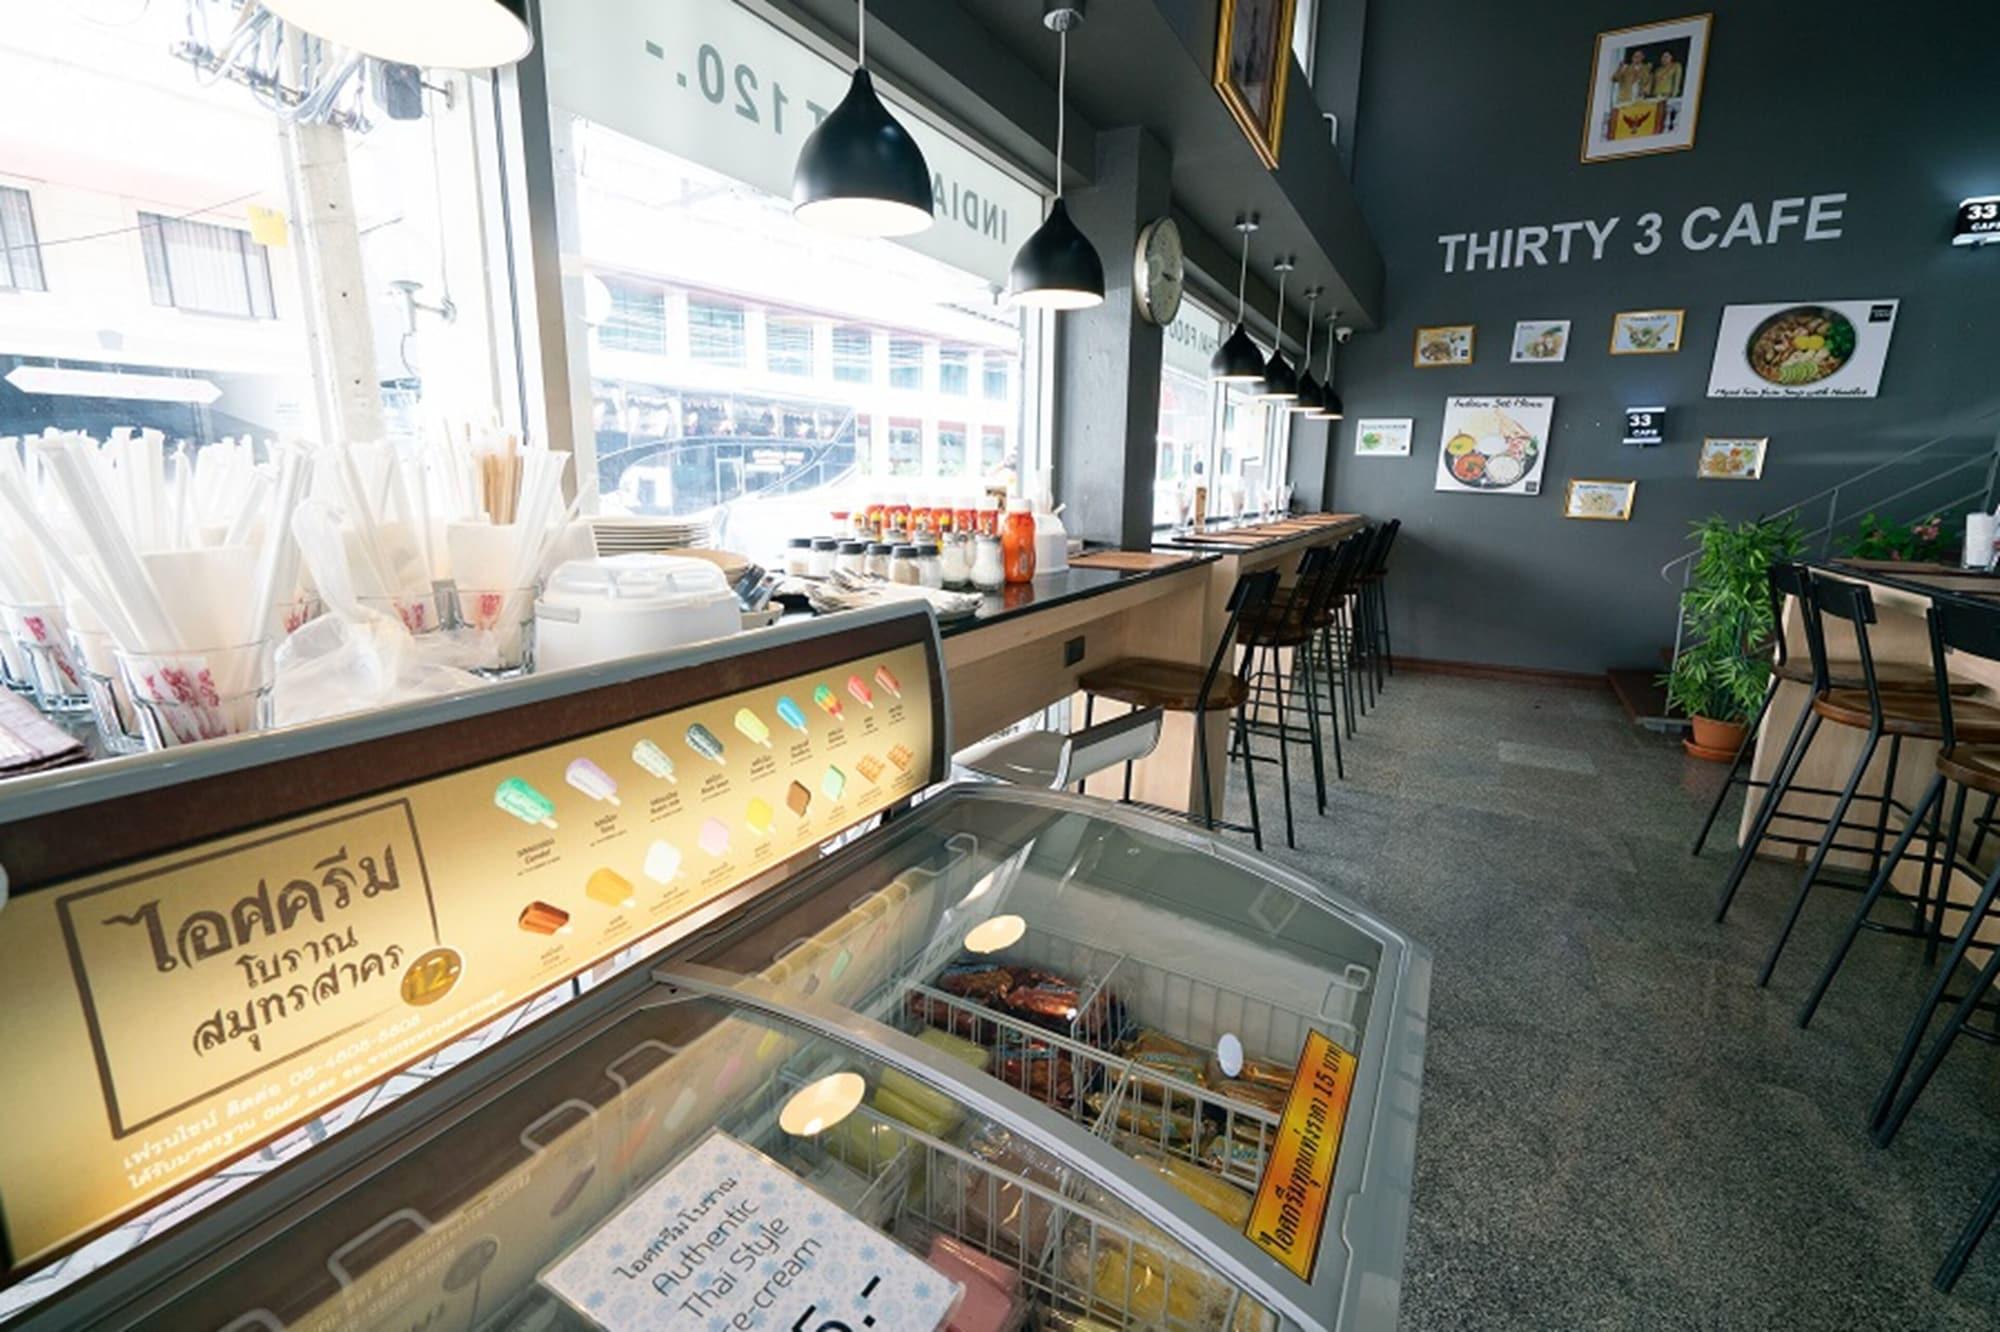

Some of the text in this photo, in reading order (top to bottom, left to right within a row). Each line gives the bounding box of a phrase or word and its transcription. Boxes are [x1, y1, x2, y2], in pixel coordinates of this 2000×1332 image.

[1438, 193, 1848, 273] THIRTY 3 CAFE
[1966, 203, 1998, 220] 33
[1629, 413, 1652, 427] 33
[102, 844, 400, 973] ไอศครีม
[236, 926, 359, 989] โบราณ
[193, 944, 404, 1057] สมุทรสาคร
[1312, 1071, 1336, 1098] 15
[652, 1199, 760, 1297] Authentic
[678, 1217, 790, 1319] Thai Style
